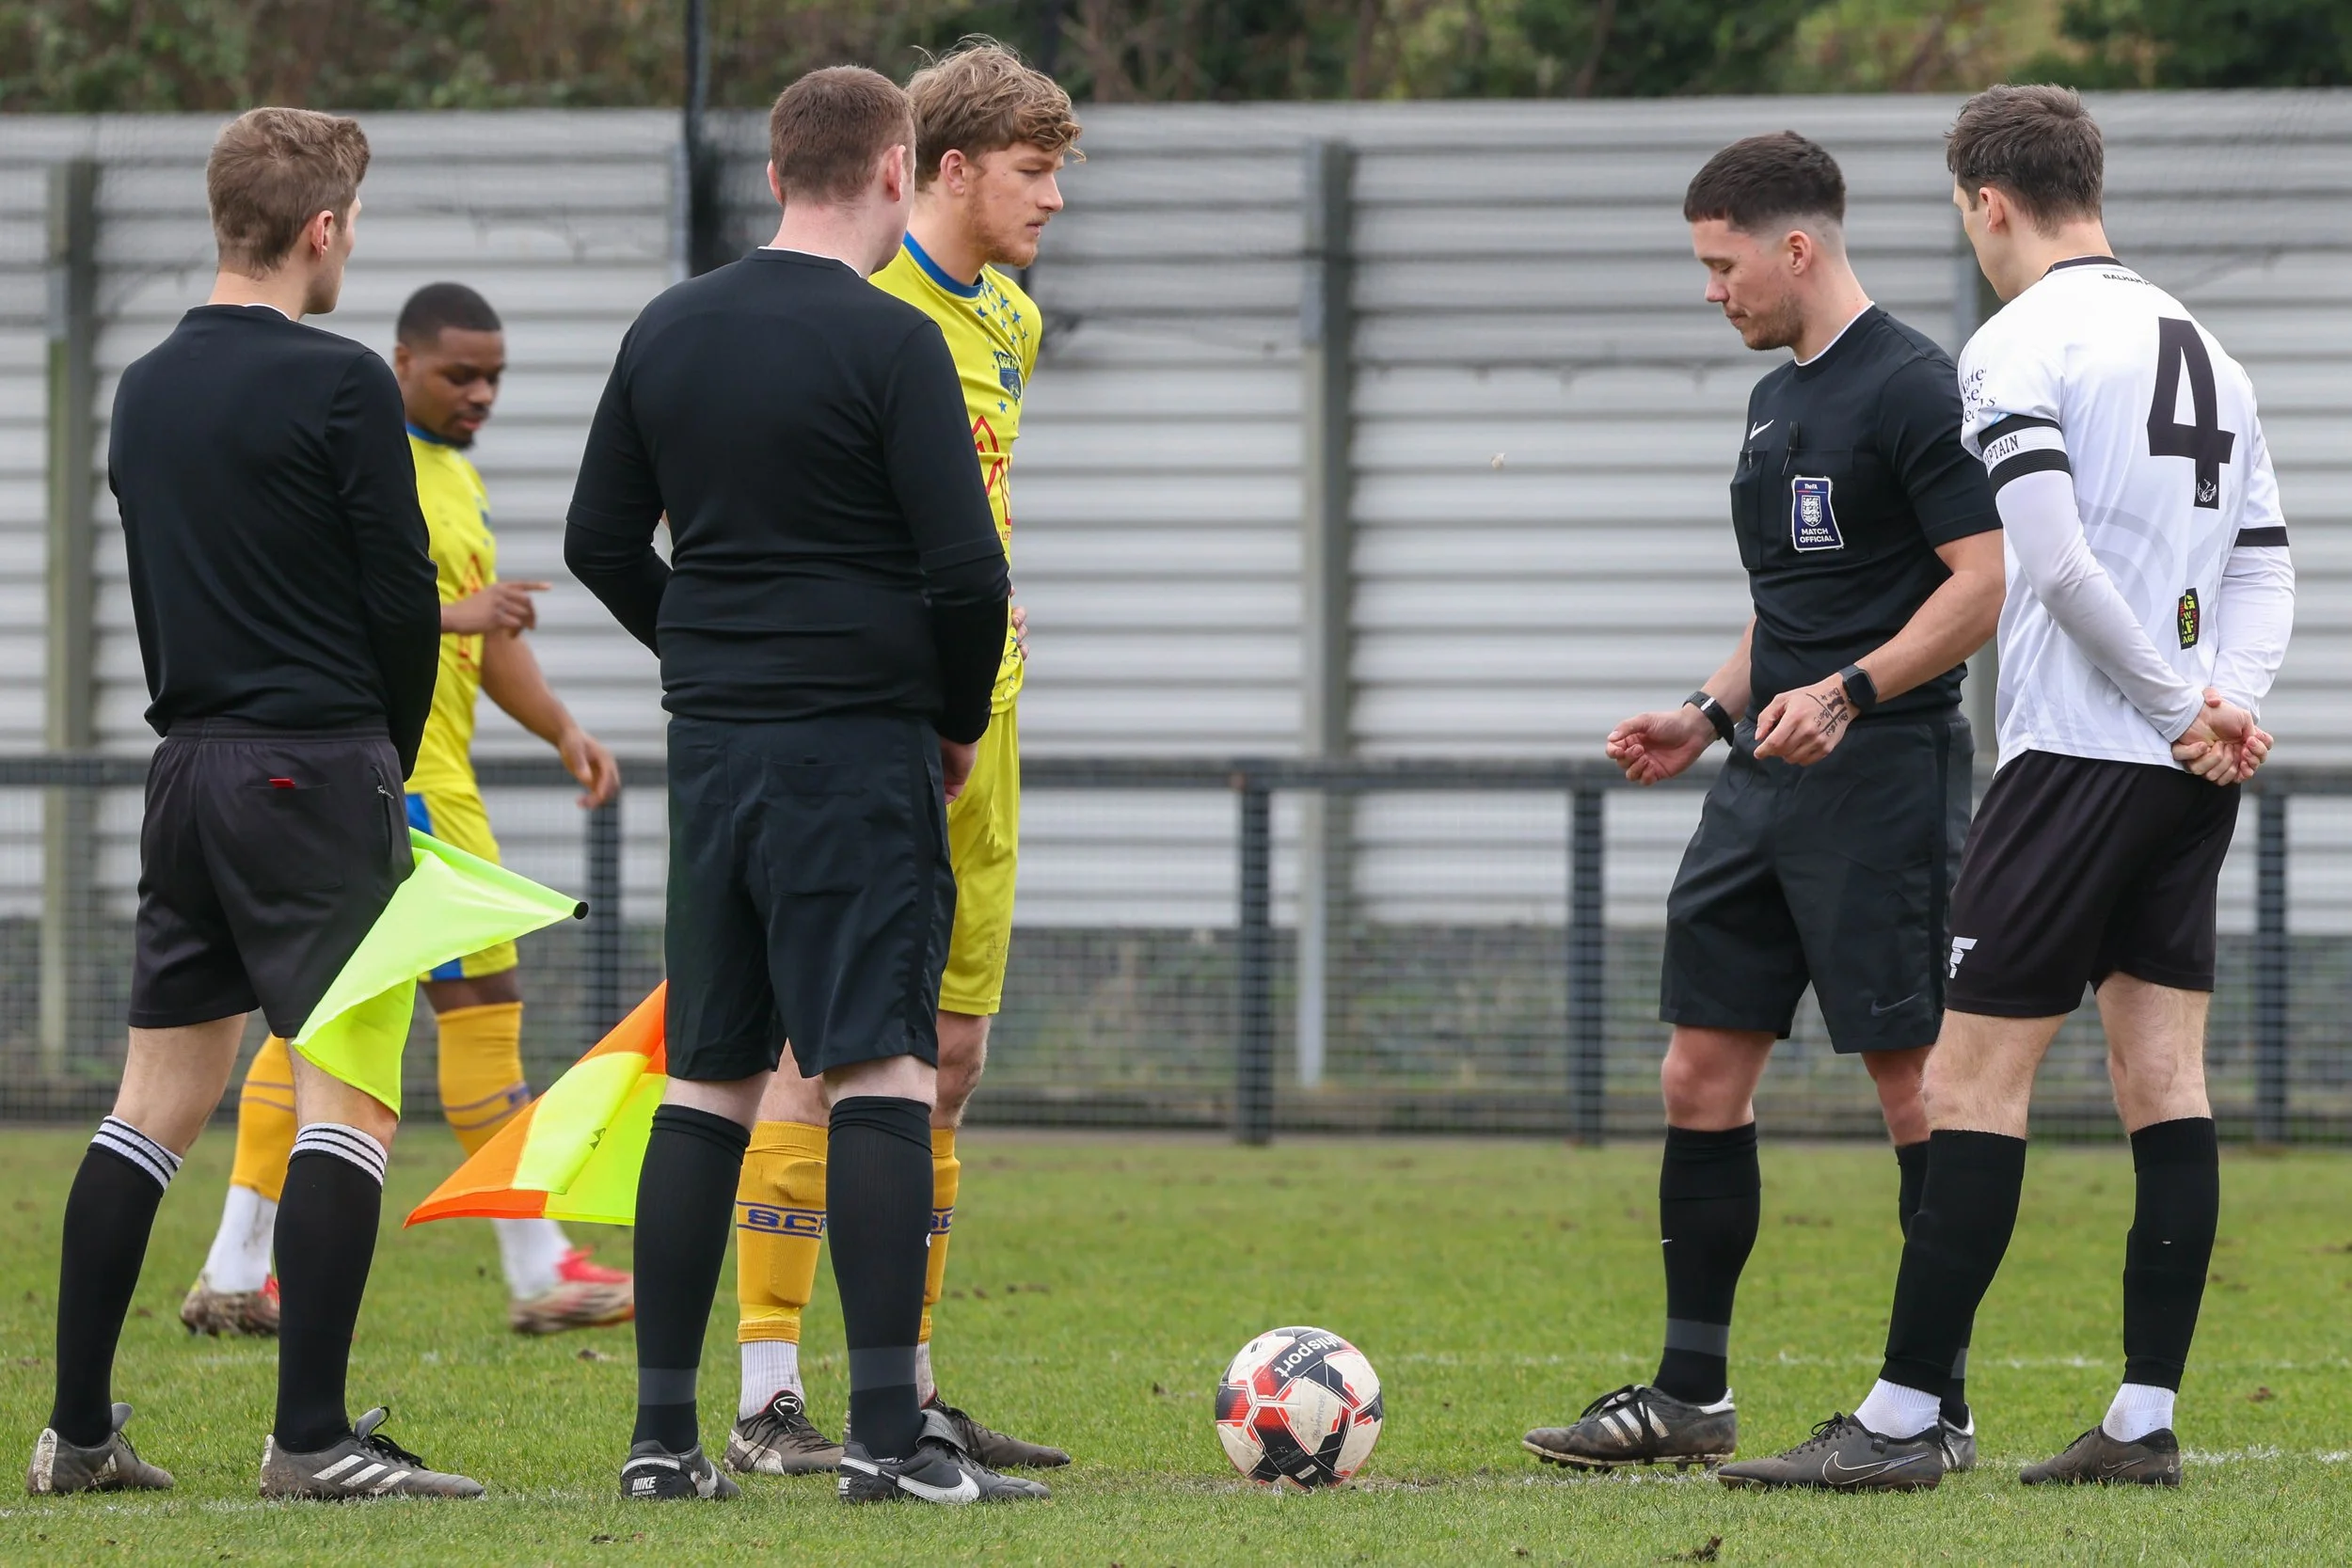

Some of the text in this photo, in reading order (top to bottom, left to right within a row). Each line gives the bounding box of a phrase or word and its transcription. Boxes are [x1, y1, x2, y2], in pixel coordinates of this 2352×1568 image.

[2147, 316, 2235, 510] 4
[1799, 535, 1836, 544] OFFICIAL
[1274, 1336, 1343, 1378] uhlsport
[631, 1476, 658, 1491] NIKE
